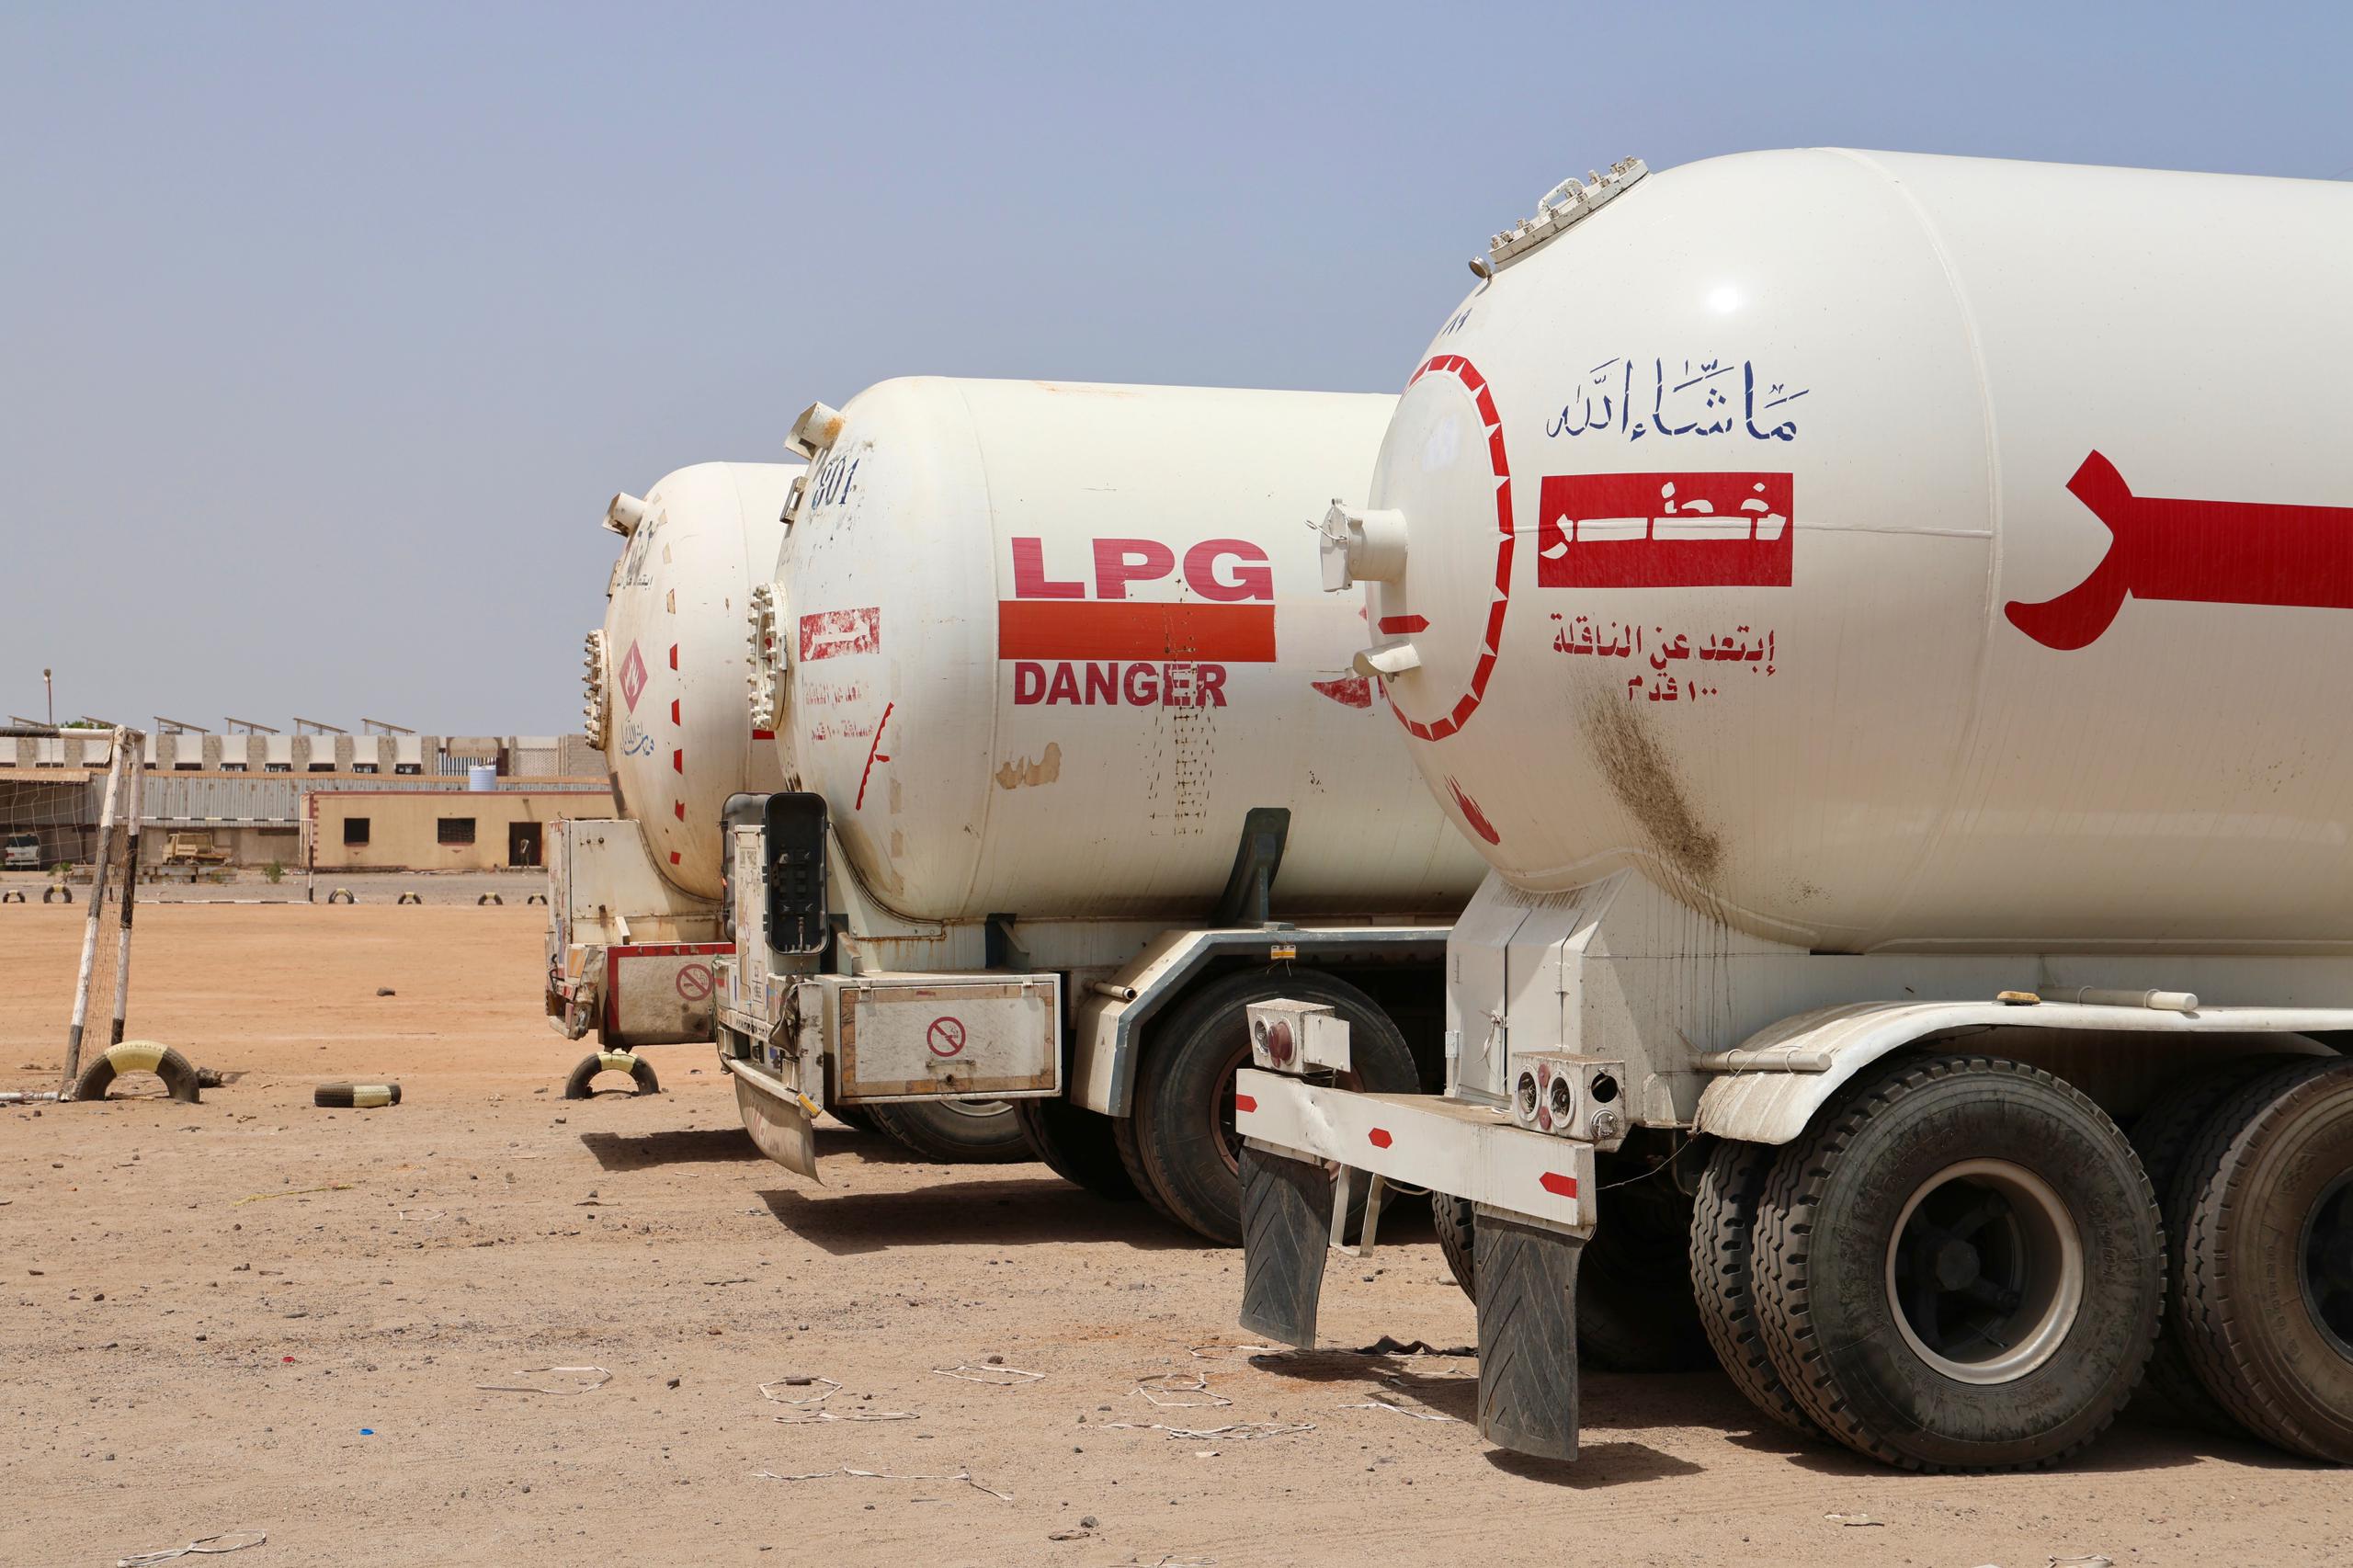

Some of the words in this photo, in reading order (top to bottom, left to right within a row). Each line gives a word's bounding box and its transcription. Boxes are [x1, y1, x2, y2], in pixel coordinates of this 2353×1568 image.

[1011, 536, 1275, 602] LPG
[1550, 612, 1643, 659] الناقلة
[1650, 626, 1691, 671] عن
[1013, 661, 1228, 707] DANGER
[1628, 672, 1678, 702] قدم
